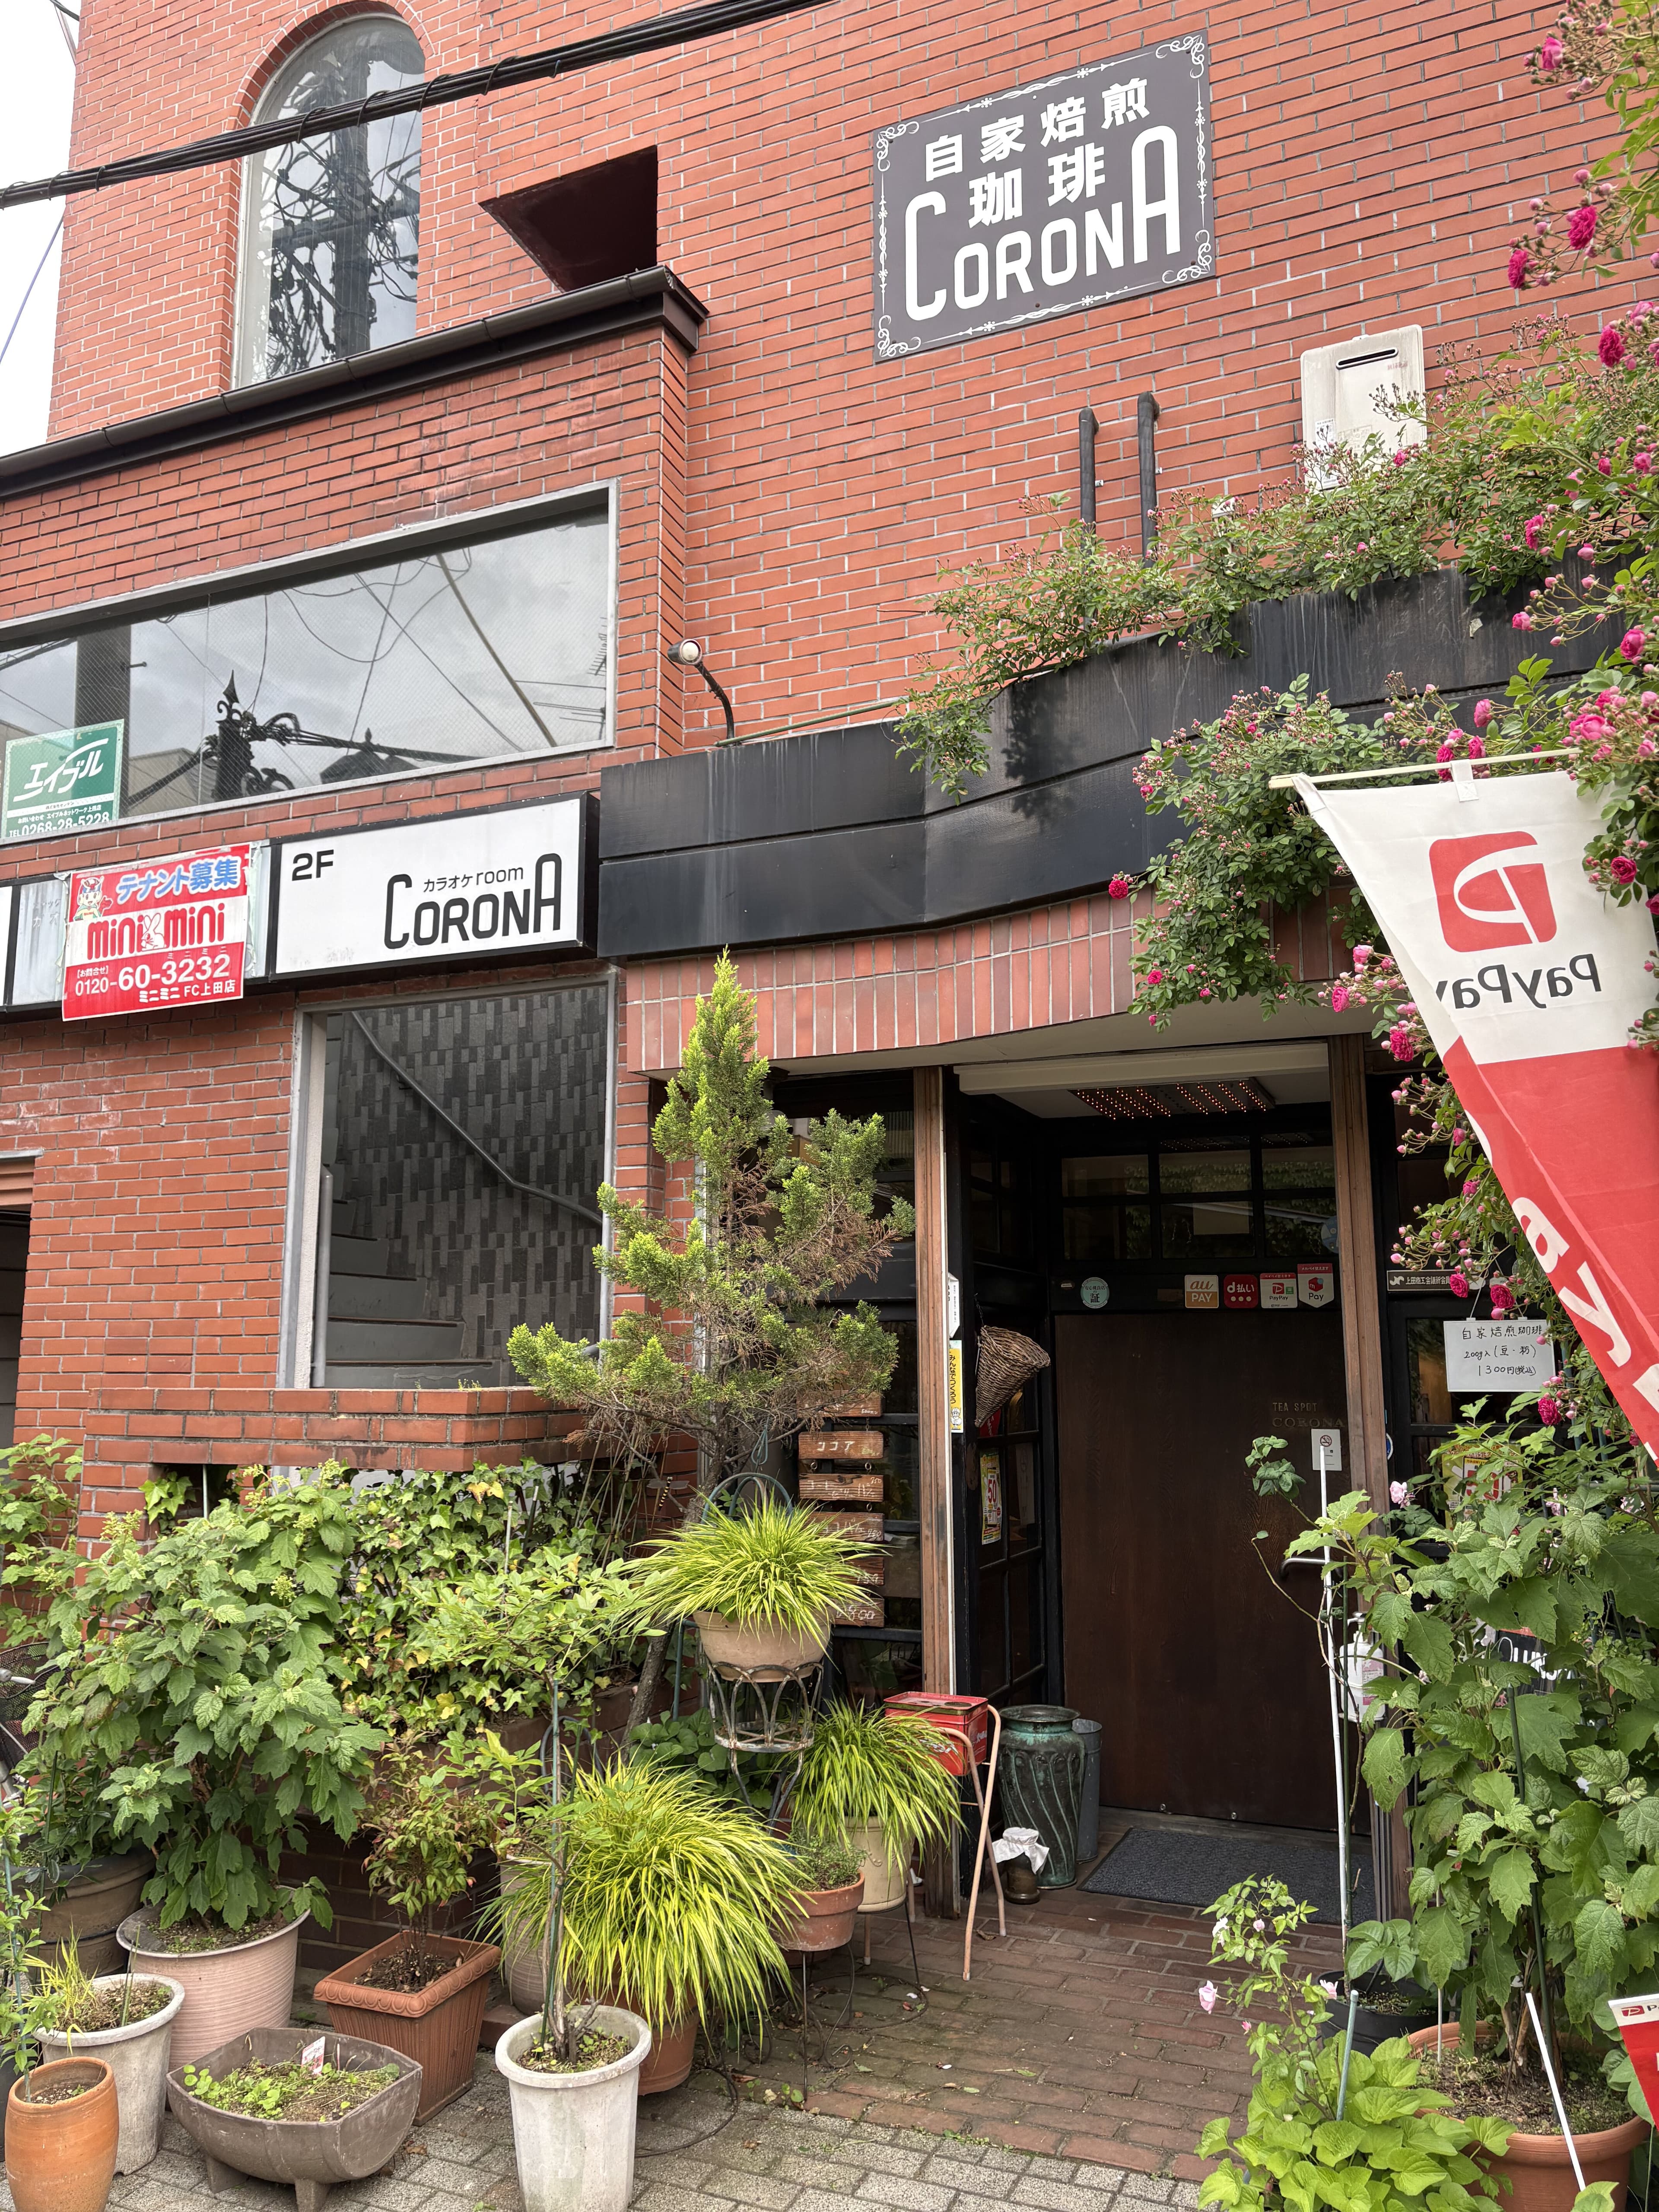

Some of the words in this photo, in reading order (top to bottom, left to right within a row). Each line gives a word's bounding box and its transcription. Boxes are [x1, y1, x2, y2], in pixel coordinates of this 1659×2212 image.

[925, 78, 1150, 182] 自家焙煎
[968, 143, 1105, 229] 珈琲
[905, 125, 1181, 321] CORONA
[13, 737, 109, 802] エイブル
[292, 849, 334, 881] 2F
[118, 858, 239, 901] テナント募集
[384, 853, 562, 949] CORONA
[87, 915, 143, 960] mini
[165, 903, 225, 948] mini
[75, 953, 230, 996] 0120-60-3232
[139, 987, 180, 1003] ミニミニ
[184, 979, 235, 997] FC上田店
[1190, 1281, 1213, 1290] au
[1192, 1293, 1211, 1302] PAY
[1227, 1282, 1254, 1293] d払い
[1309, 1293, 1324, 1301] Pay
[1462, 1325, 1542, 1339] 自家焙煎珈琲
[1273, 1402, 1288, 1411] TEA
[1295, 1403, 1317, 1412] SPOT
[1272, 1417, 1344, 1427] CORONA
[988, 1479, 996, 1503] 50
